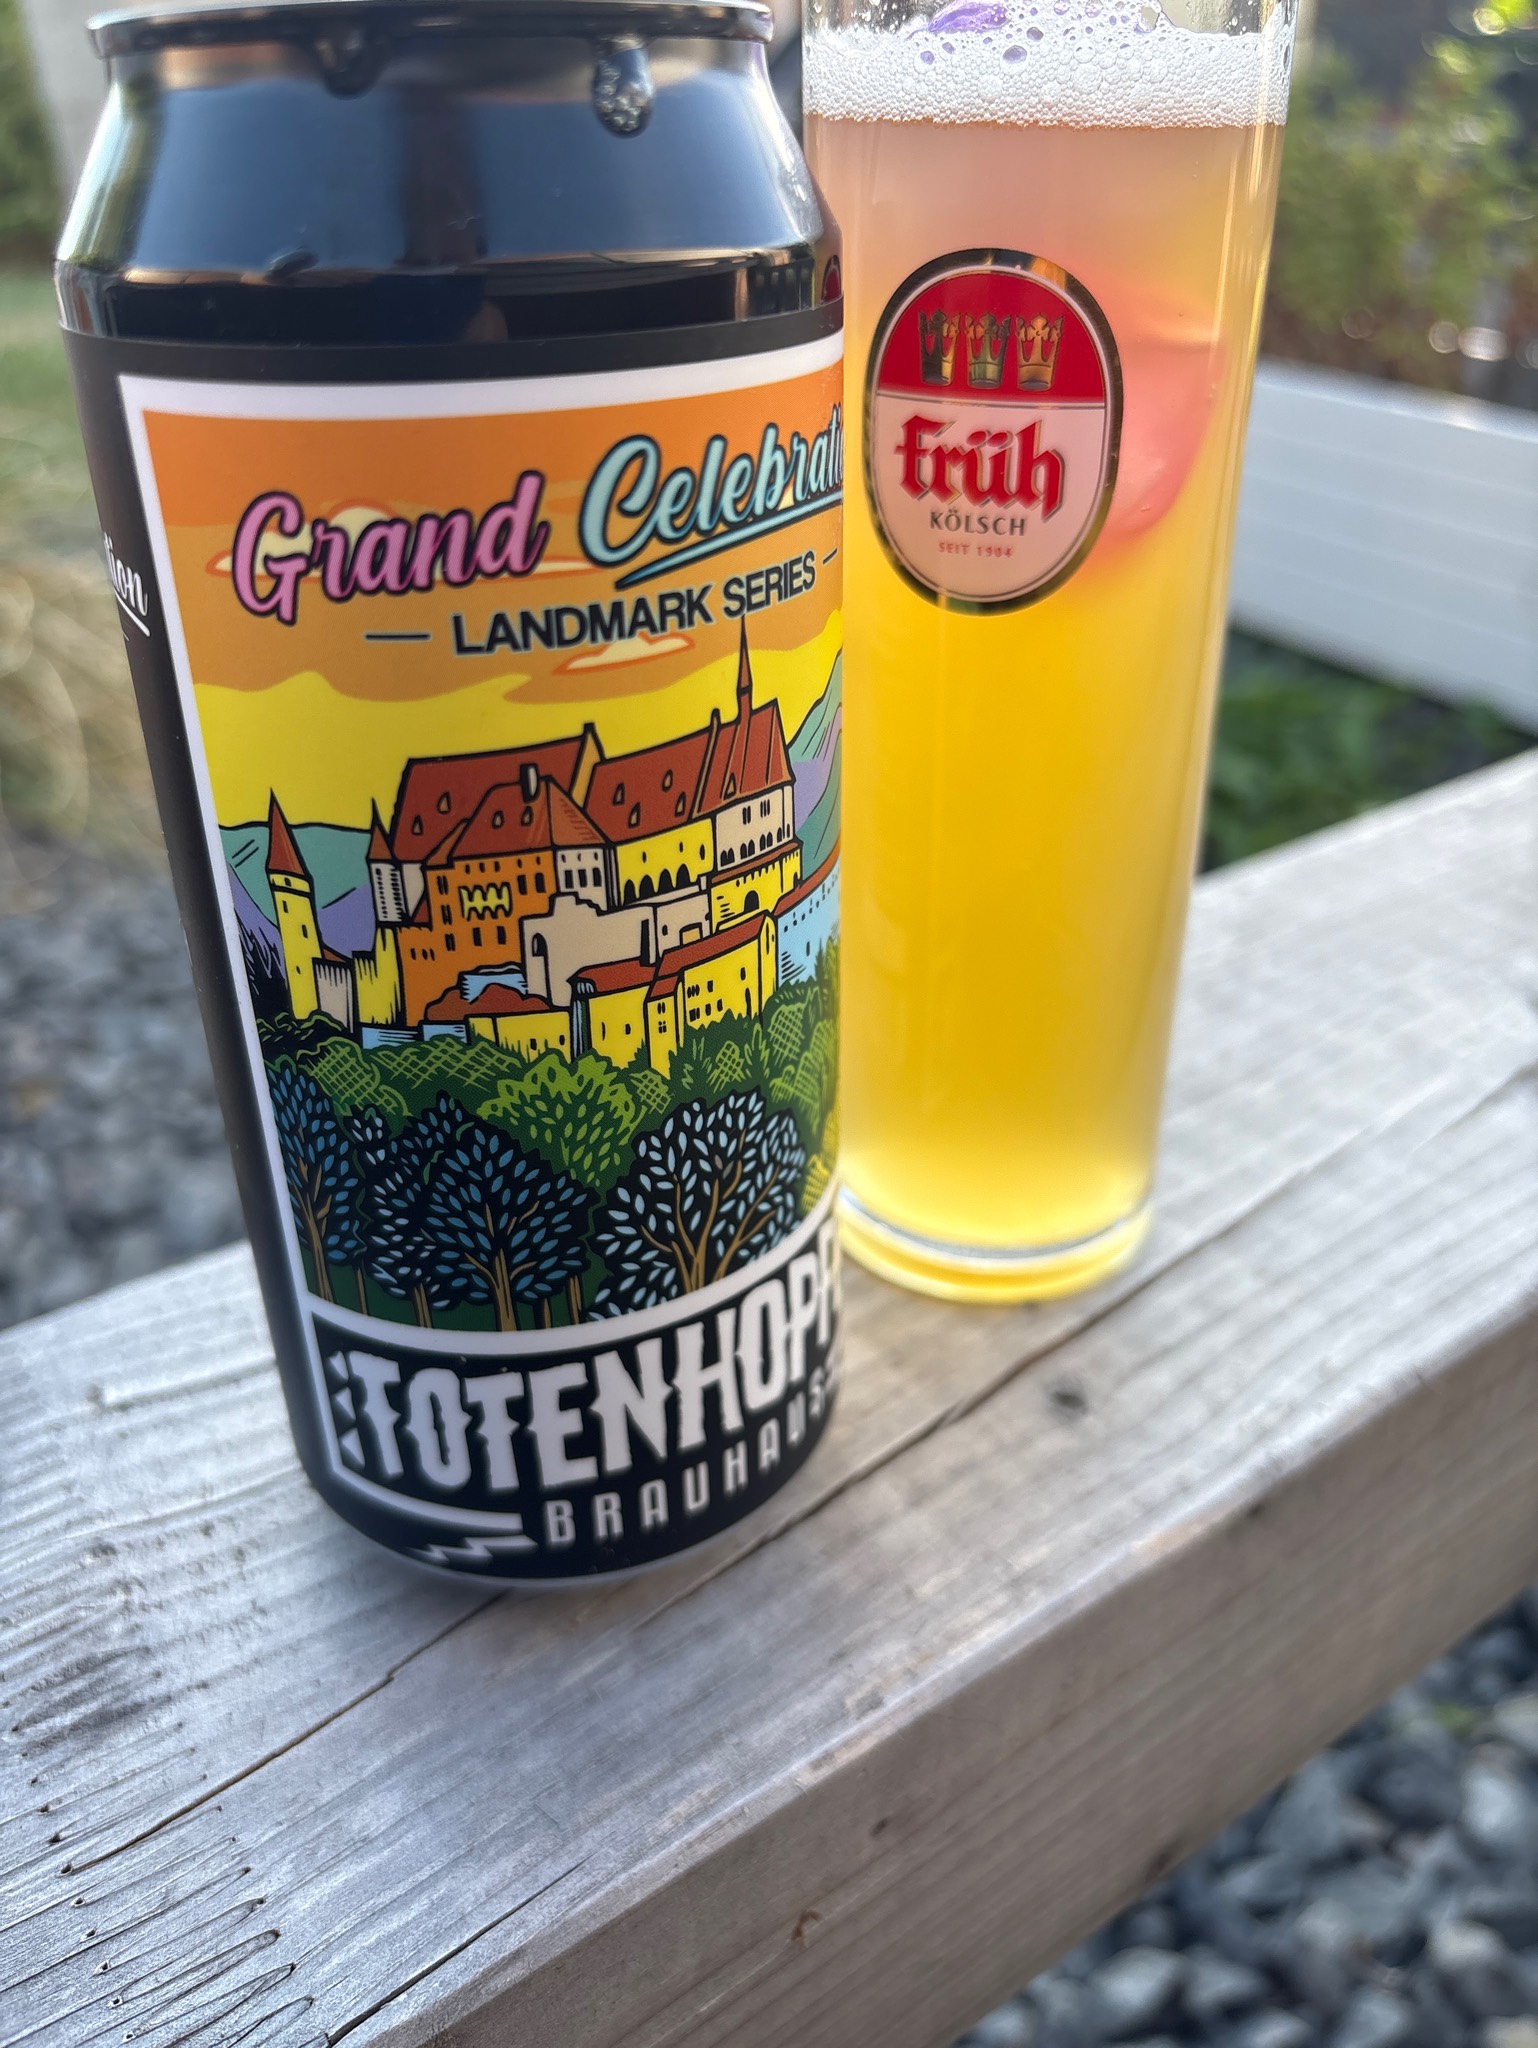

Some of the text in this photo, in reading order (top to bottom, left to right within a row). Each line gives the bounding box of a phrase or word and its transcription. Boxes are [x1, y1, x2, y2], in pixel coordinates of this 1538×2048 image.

[232, 402, 844, 625] Grand Celebrati
[930, 508, 1026, 537] KÖLSCH
[938, 541, 1014, 558] SEIT 1904
[452, 550, 817, 655] LANDMARK SERIES
[542, 1364, 826, 1550] BRAUHAUS
